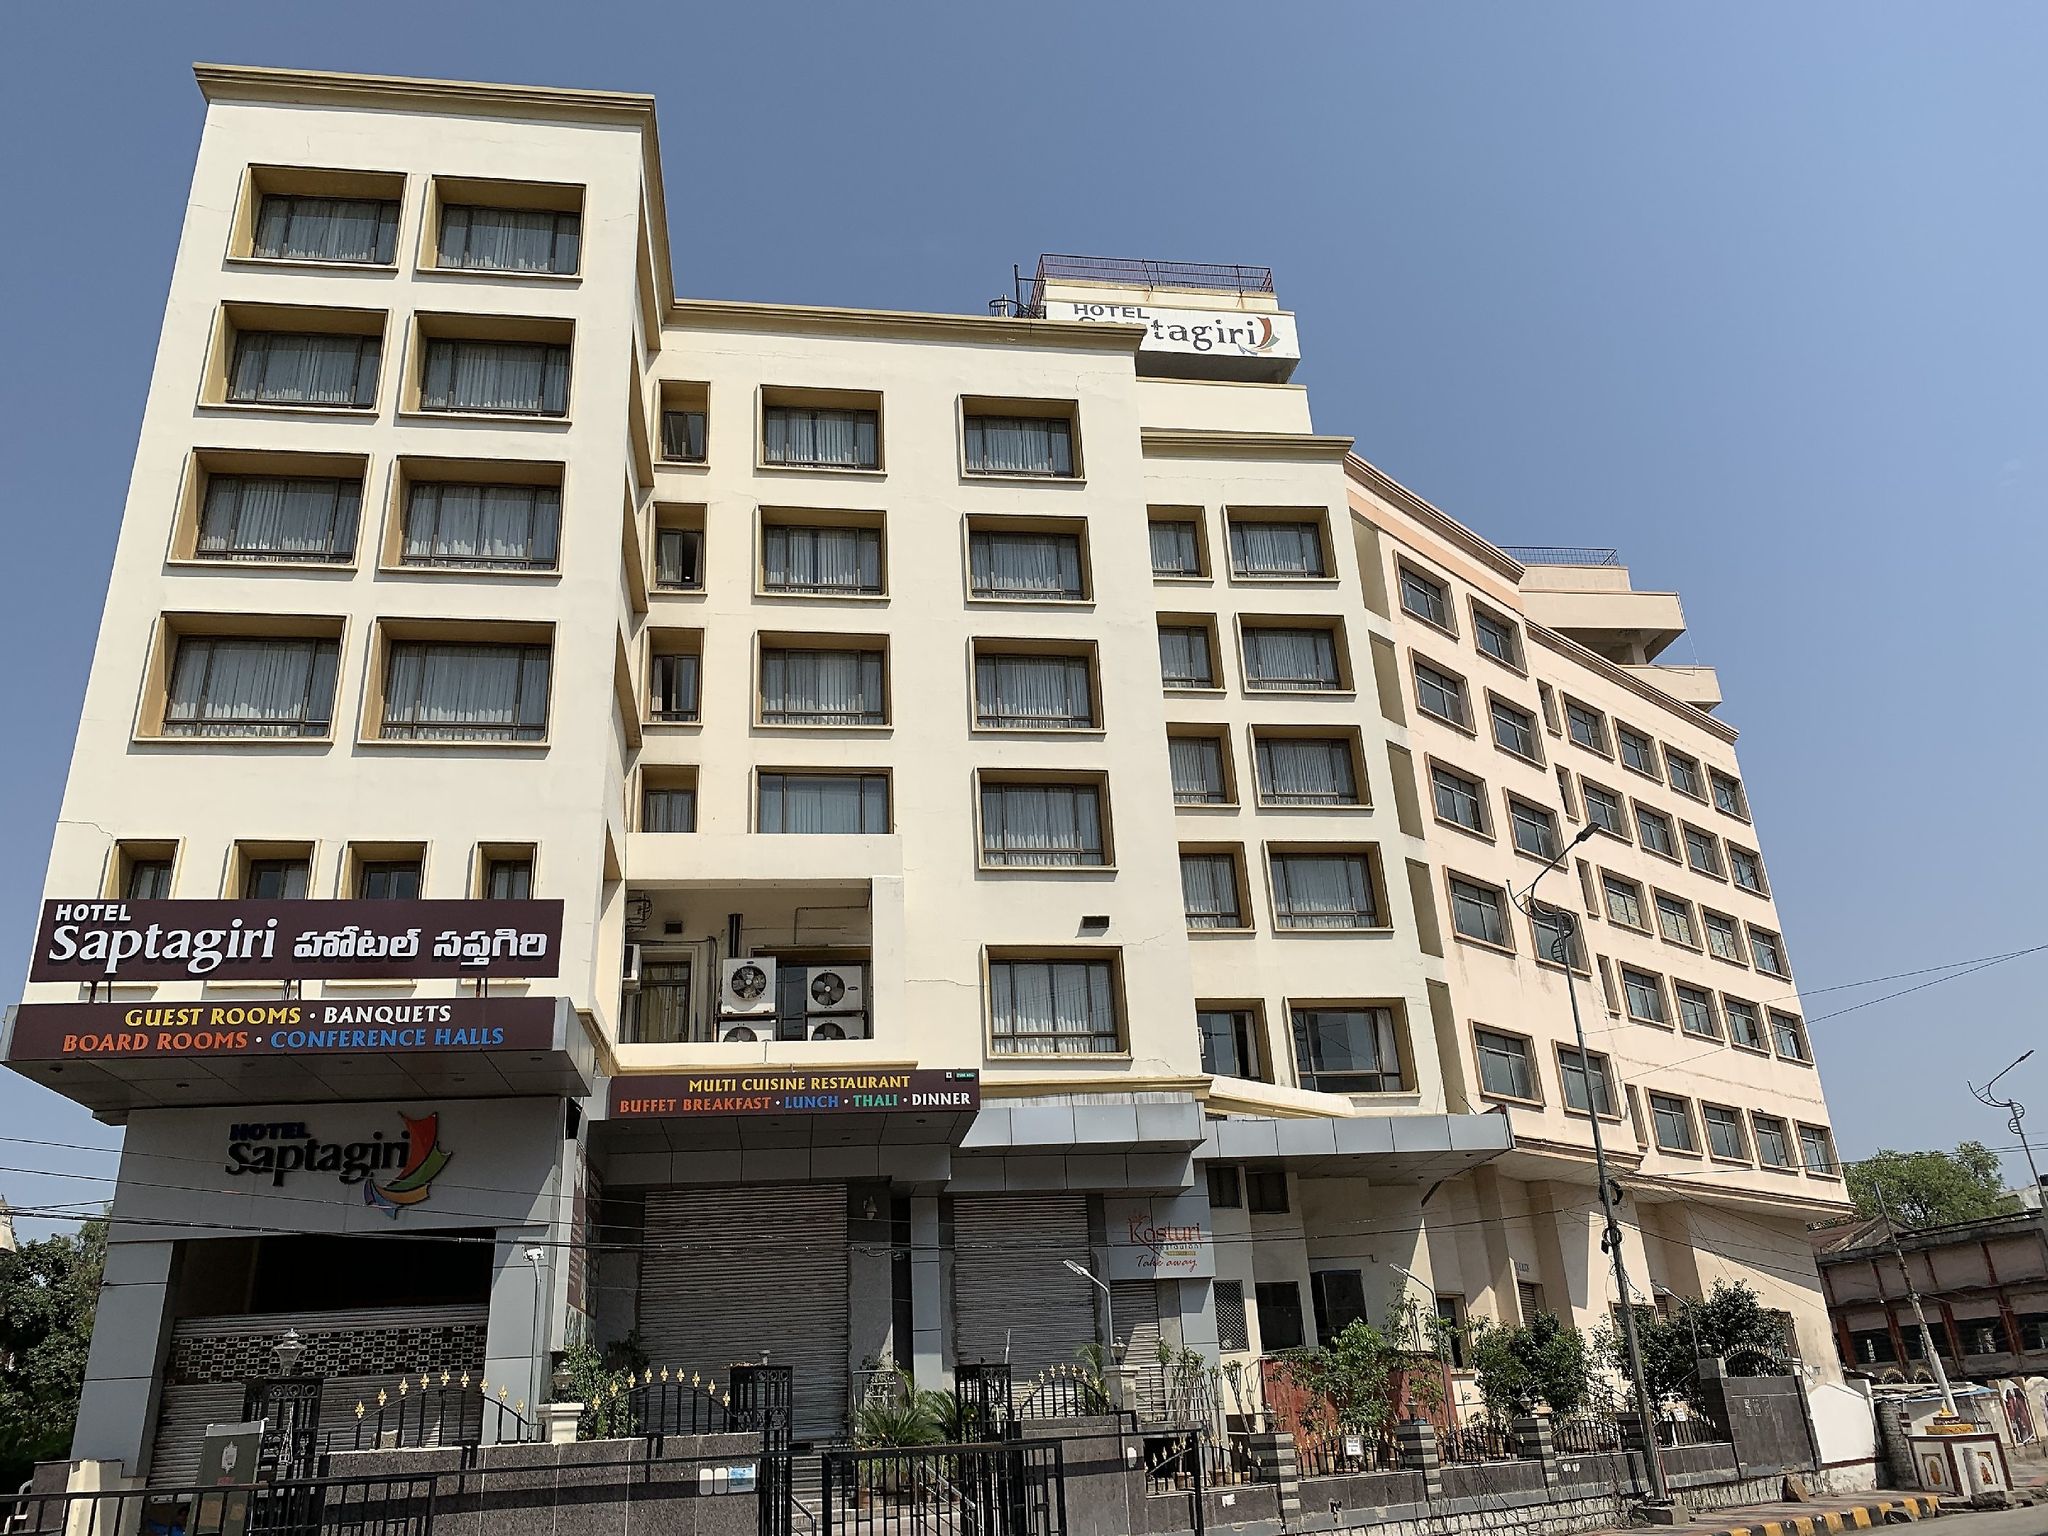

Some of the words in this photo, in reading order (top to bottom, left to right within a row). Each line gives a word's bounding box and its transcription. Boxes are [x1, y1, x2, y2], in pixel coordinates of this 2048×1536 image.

[1074, 303, 1150, 319] HOTEL
[55, 904, 132, 921] HOTEL
[49, 918, 278, 974] Saptagiri
[433, 928, 548, 966] సప్తగిరి
[125, 1008, 204, 1026] GUEST
[210, 1007, 301, 1025] ROOMS
[323, 1005, 452, 1025] BANQUETS
[62, 1033, 149, 1052] BOARD
[157, 1031, 248, 1050] ROOMS
[270, 1028, 426, 1048] CONFERENCE
[434, 1027, 505, 1046] HALLS
[688, 1079, 736, 1092] MULTI
[742, 1077, 806, 1091] CUISINE
[811, 1075, 911, 1090] RESTAURANT
[619, 1098, 677, 1113] BUFFET
[682, 1096, 772, 1112] BREAKFAST
[784, 1095, 839, 1109] LUNCH
[853, 1094, 898, 1107] THALI
[911, 1092, 971, 1106] DINNER
[229, 1122, 311, 1141] HOTEL
[224, 1131, 411, 1187] Saptagiri
[1128, 1216, 1203, 1246] Kasturi
[1136, 1254, 1163, 1268] Take
